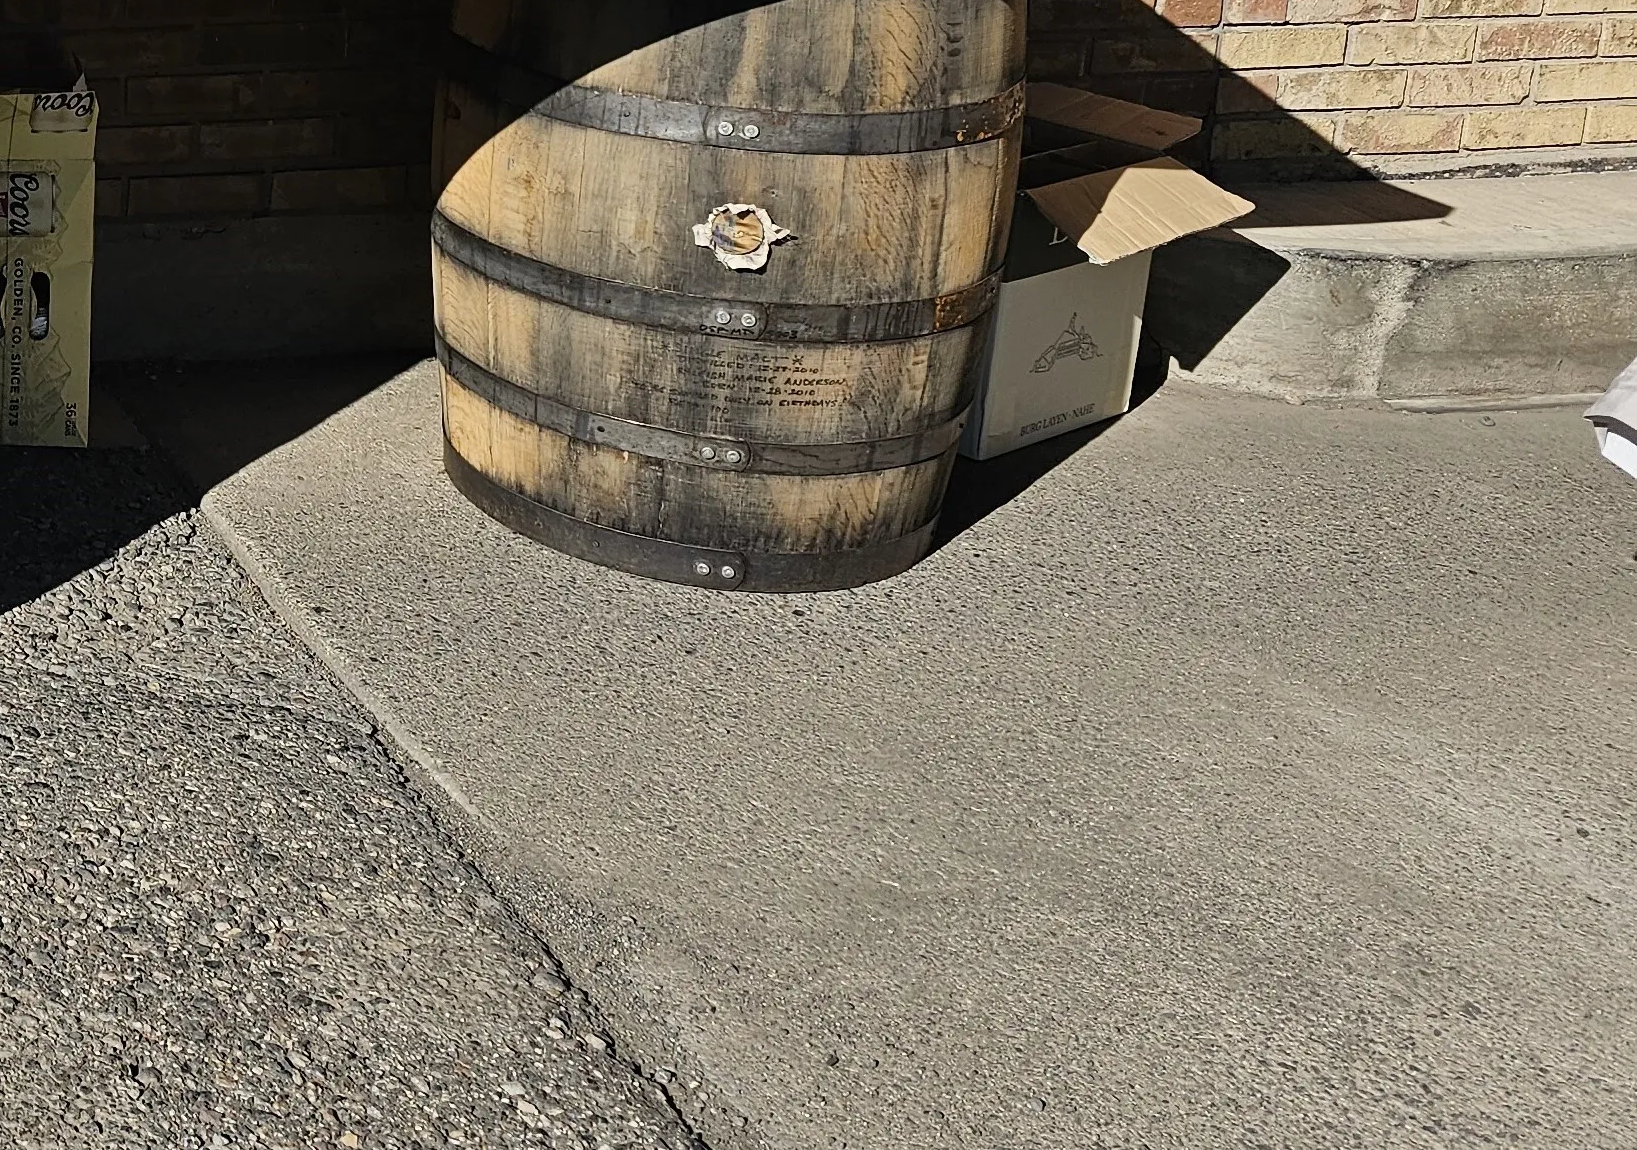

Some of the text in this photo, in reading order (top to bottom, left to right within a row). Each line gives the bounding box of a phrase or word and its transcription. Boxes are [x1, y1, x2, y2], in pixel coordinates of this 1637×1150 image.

[34, 92, 95, 117] Coors
[8, 172, 40, 237] Coors
[10, 353, 21, 394] SINCE
[8, 398, 20, 427] 1873
[65, 402, 77, 418] 36
